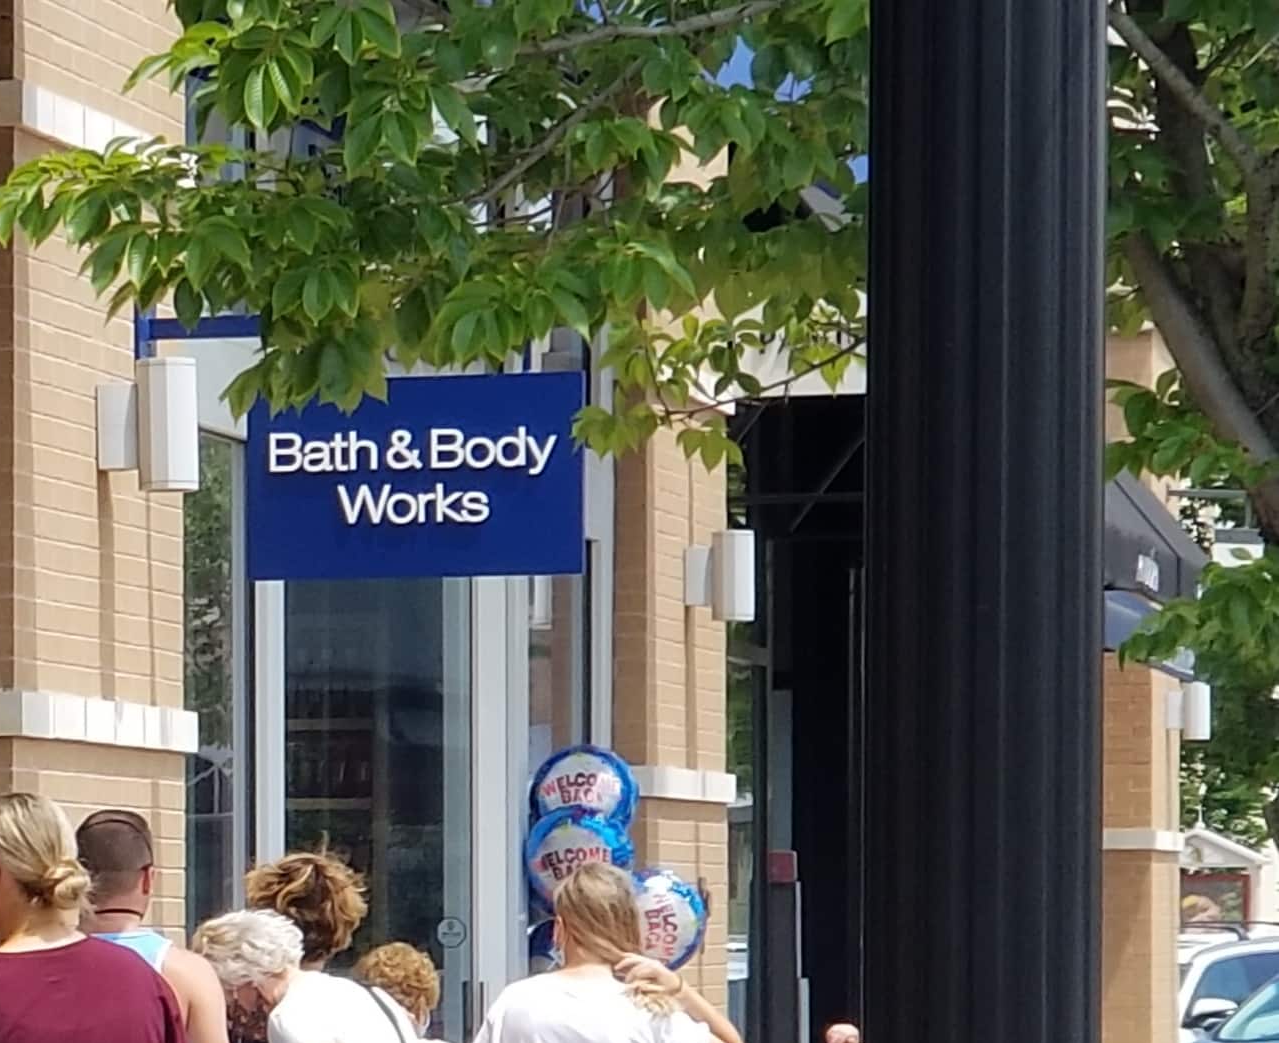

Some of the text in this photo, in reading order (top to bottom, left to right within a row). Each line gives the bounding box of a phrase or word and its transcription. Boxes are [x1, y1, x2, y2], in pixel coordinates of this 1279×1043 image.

[268, 425, 558, 476] Bath & Body
[337, 482, 491, 526] Works
